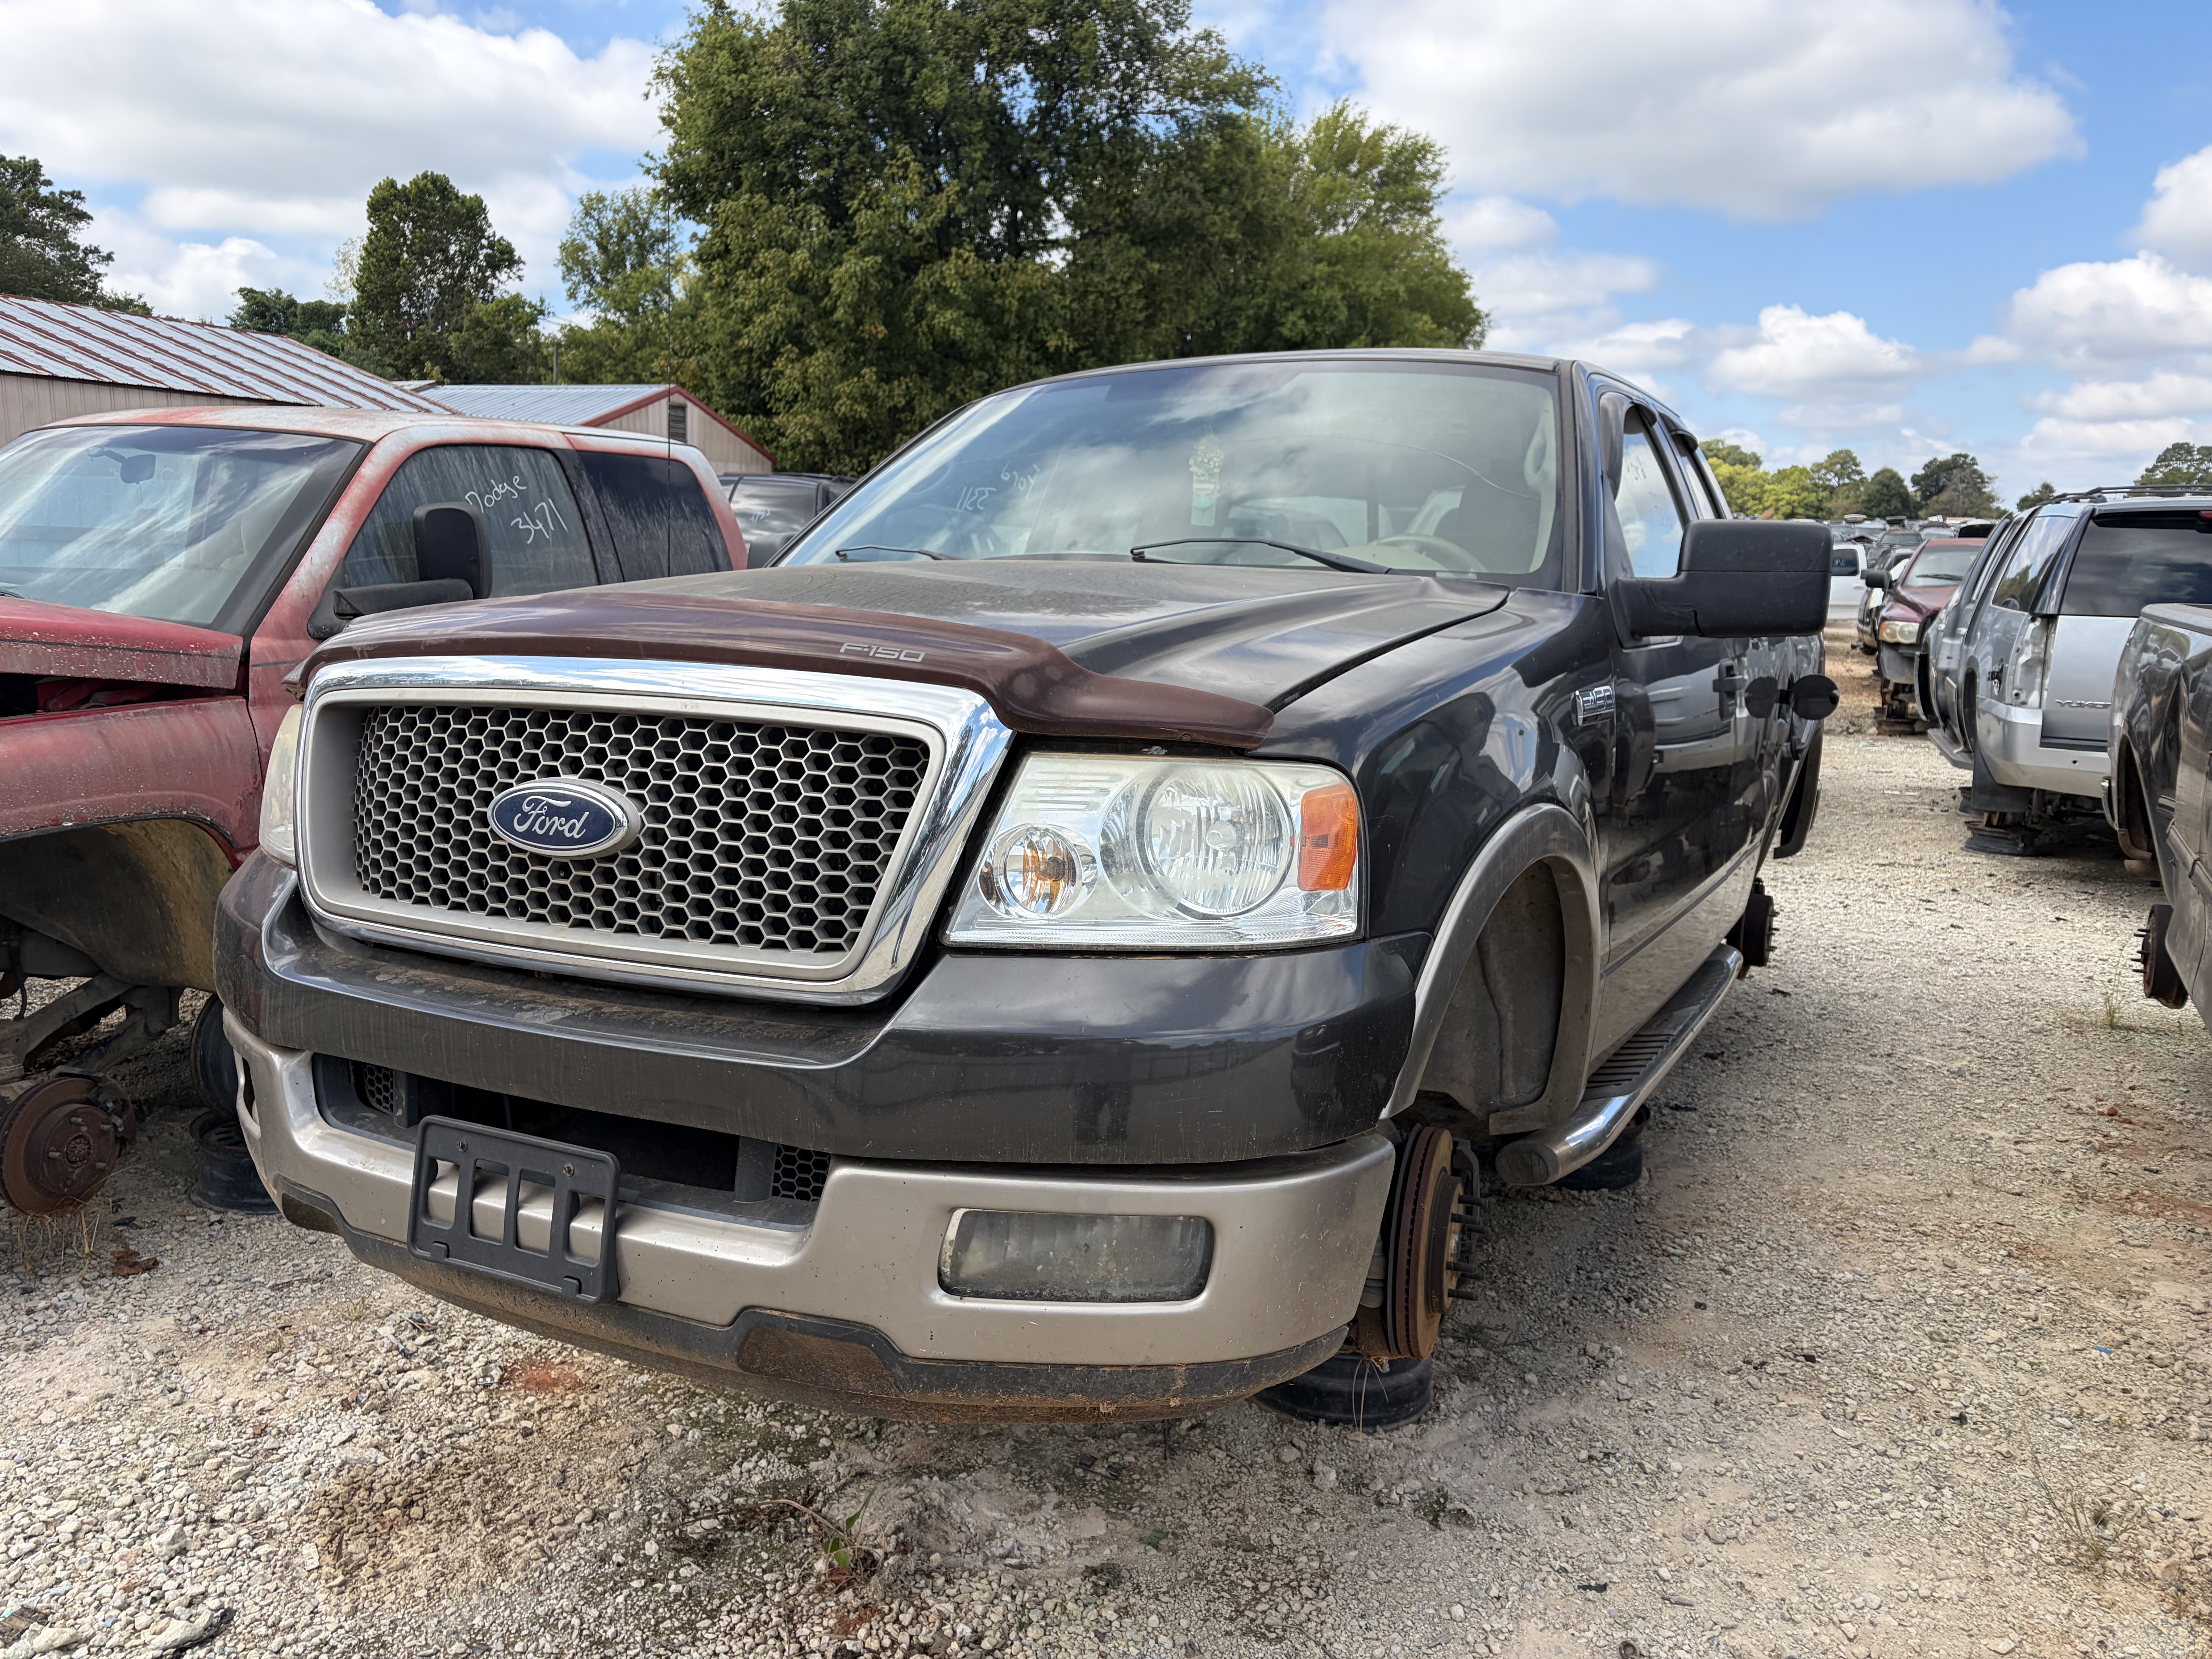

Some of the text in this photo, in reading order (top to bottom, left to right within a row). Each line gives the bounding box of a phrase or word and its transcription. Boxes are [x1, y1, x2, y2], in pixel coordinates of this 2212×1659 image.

[465, 475, 527, 514] Dodge
[510, 498, 568, 544] 3471
[839, 642, 926, 662] F-150
[513, 795, 589, 839] Ford
